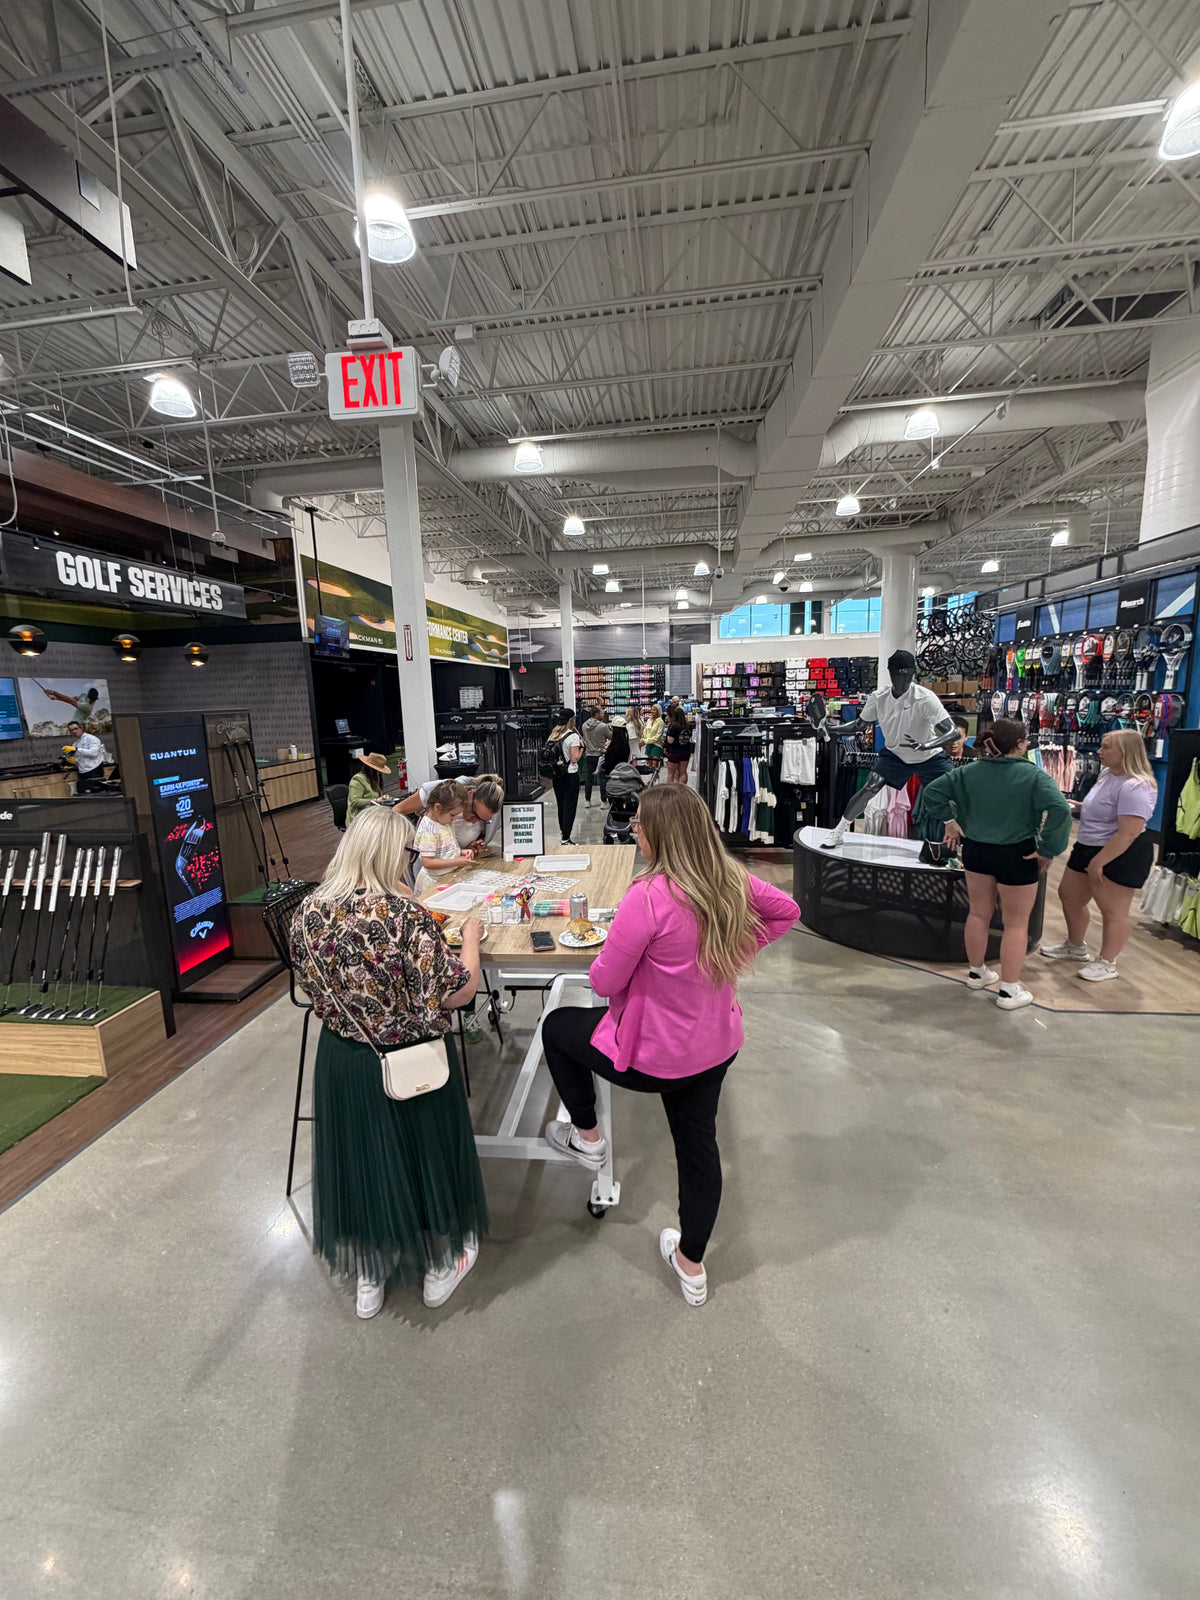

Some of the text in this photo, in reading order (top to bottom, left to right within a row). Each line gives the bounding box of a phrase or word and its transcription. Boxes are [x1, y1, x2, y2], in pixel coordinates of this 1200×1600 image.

[341, 351, 403, 409] EXIT
[55, 550, 223, 611] GOLF SERVICES
[452, 627, 469, 645] CENTER
[149, 748, 196, 760] QUANTUM
[175, 798, 191, 812] $20
